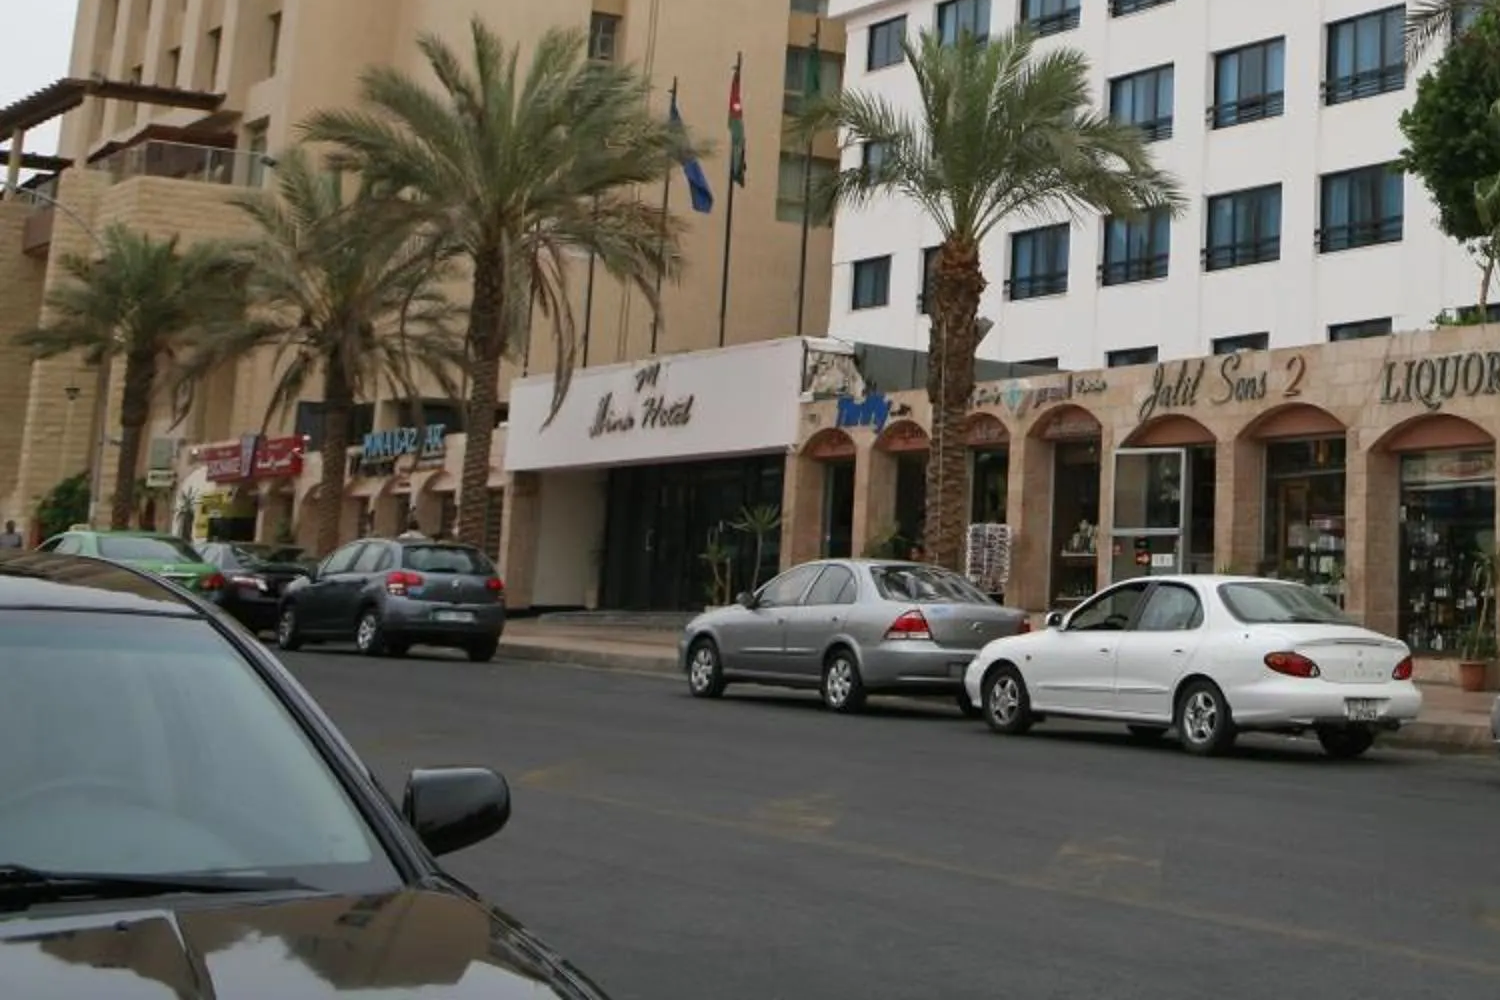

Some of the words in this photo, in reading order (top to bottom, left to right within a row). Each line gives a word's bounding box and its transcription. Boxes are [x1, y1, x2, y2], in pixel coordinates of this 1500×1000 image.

[641, 393, 694, 429] Hotel
[1138, 360, 1205, 424] Jalil
[1211, 352, 1268, 406] Sons
[1283, 353, 1307, 398] 2
